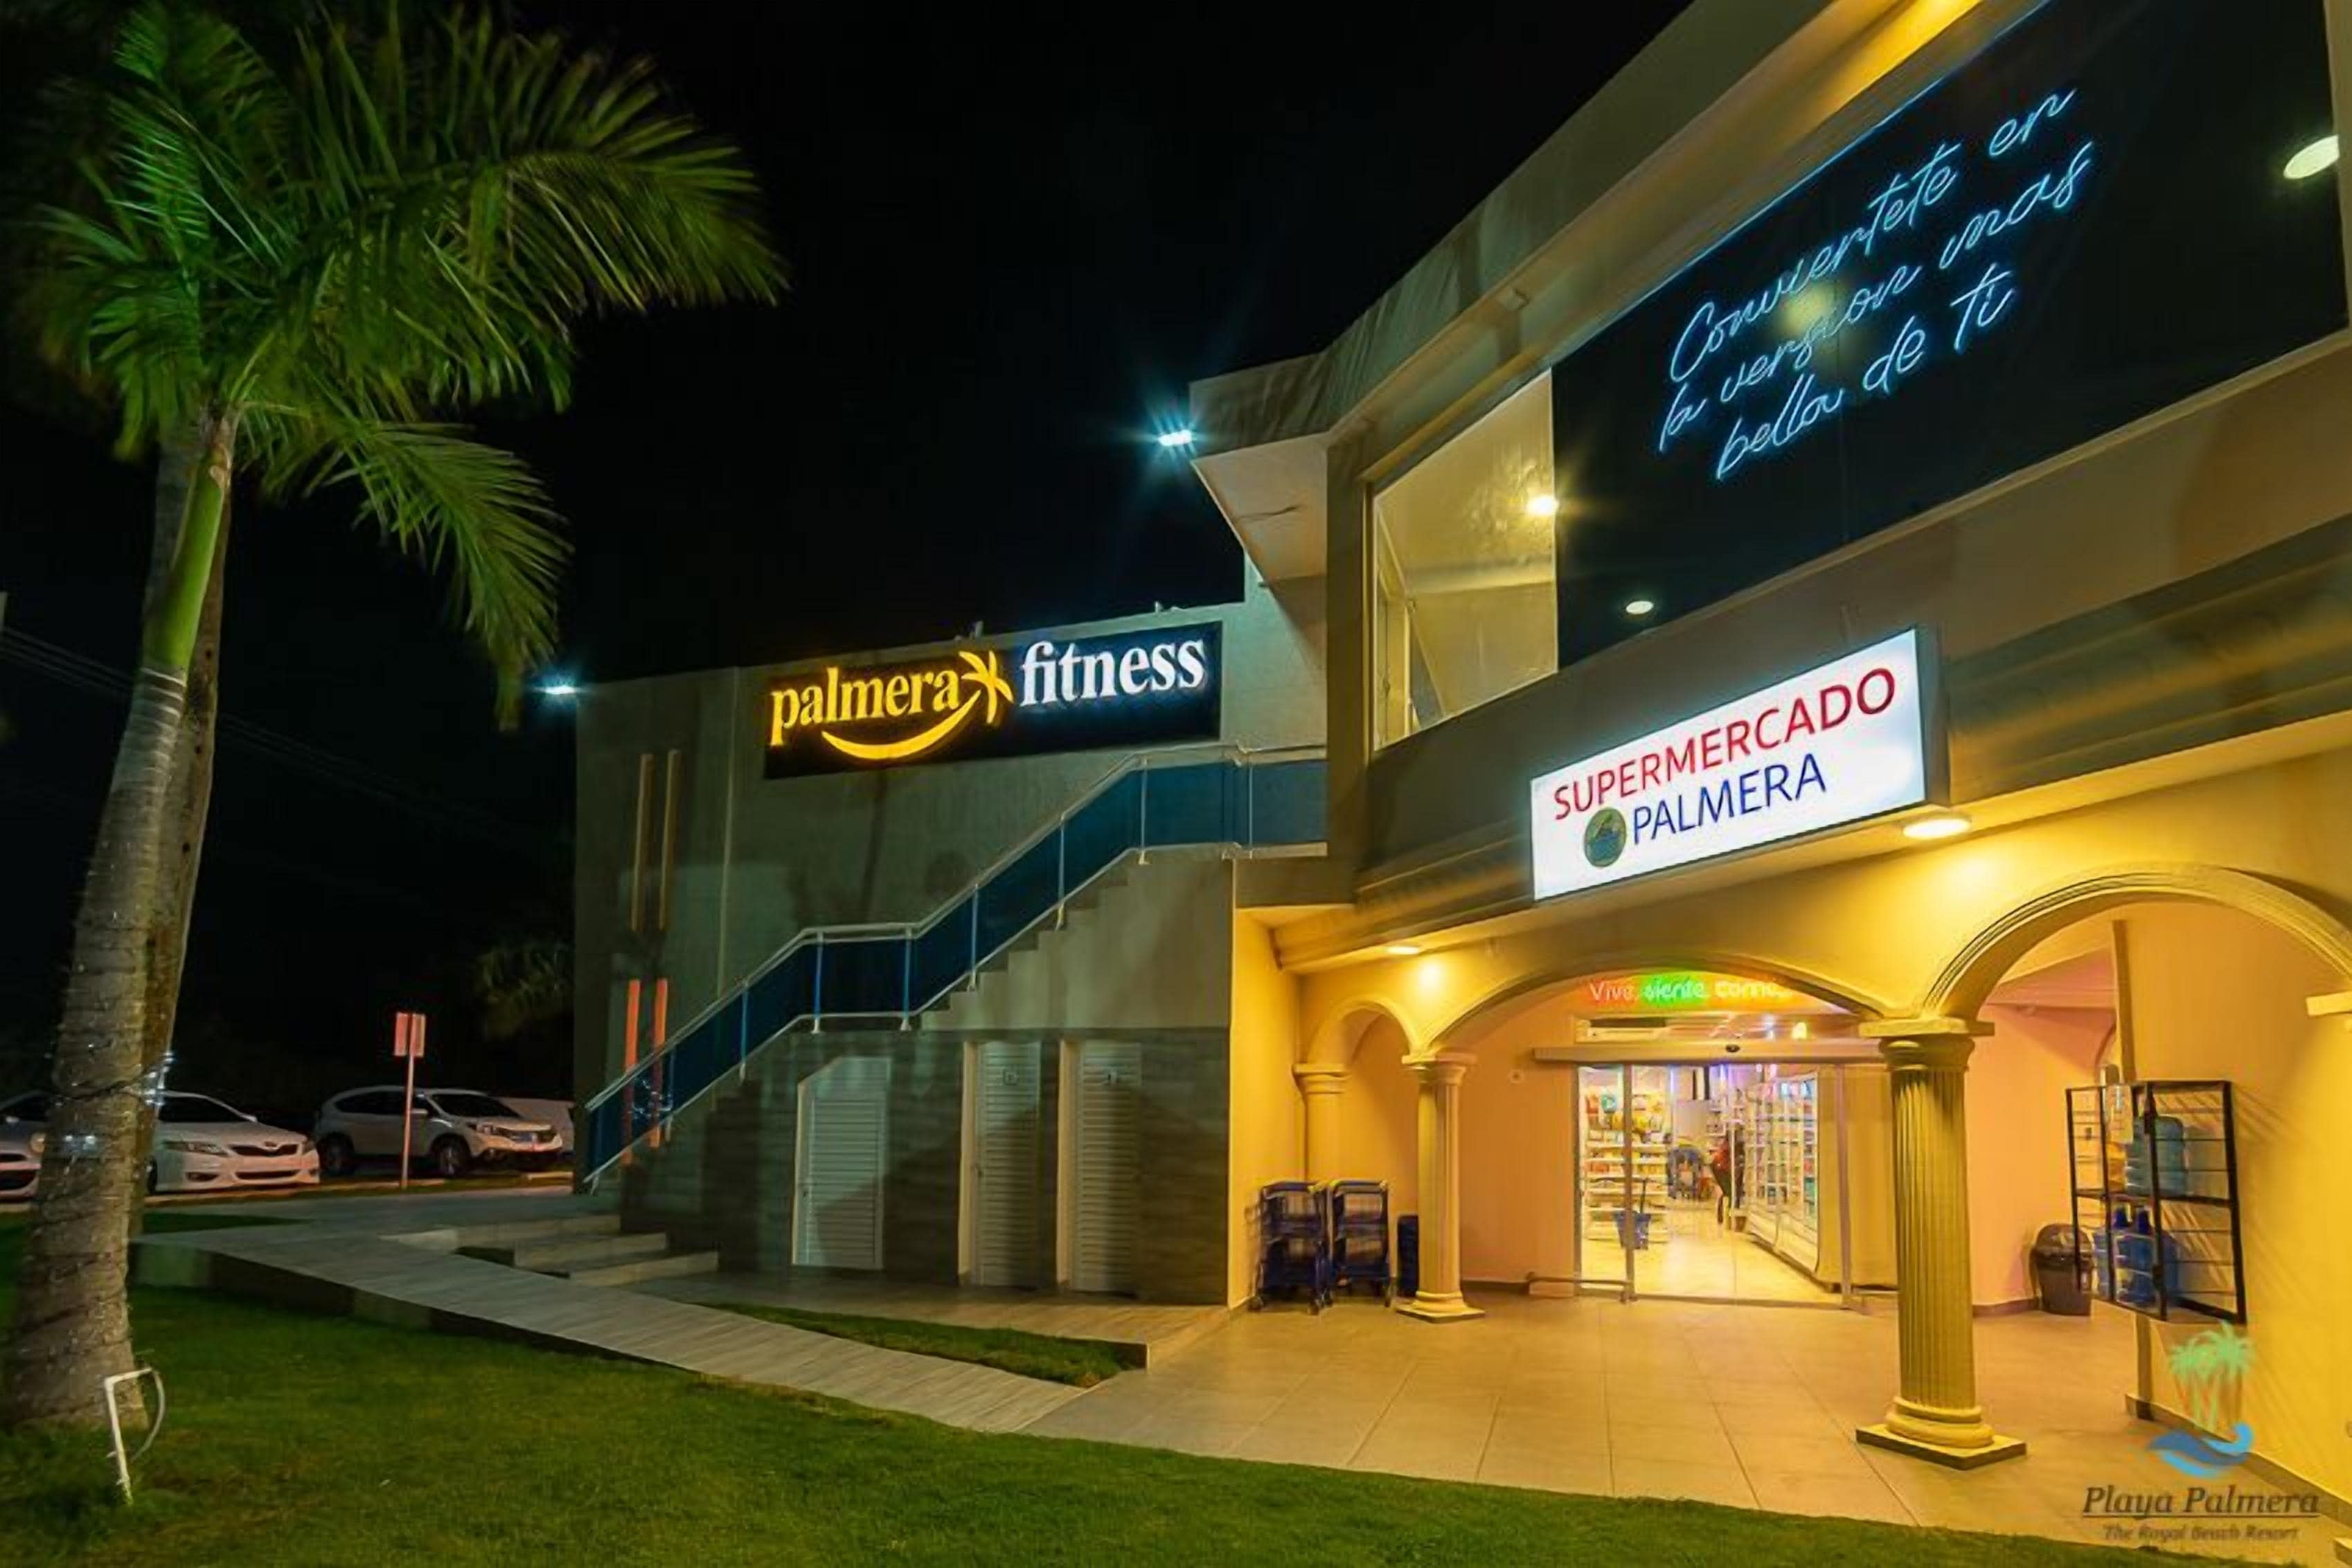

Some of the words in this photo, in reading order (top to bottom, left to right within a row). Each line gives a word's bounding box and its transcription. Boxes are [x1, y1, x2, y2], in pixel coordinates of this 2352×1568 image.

[1862, 314, 1927, 394] de
[769, 667, 960, 747] palmera
[1019, 640, 1205, 709] fitness
[1554, 668, 1896, 820] SUPERMERCADO
[1632, 753, 1827, 845] PALMERA
